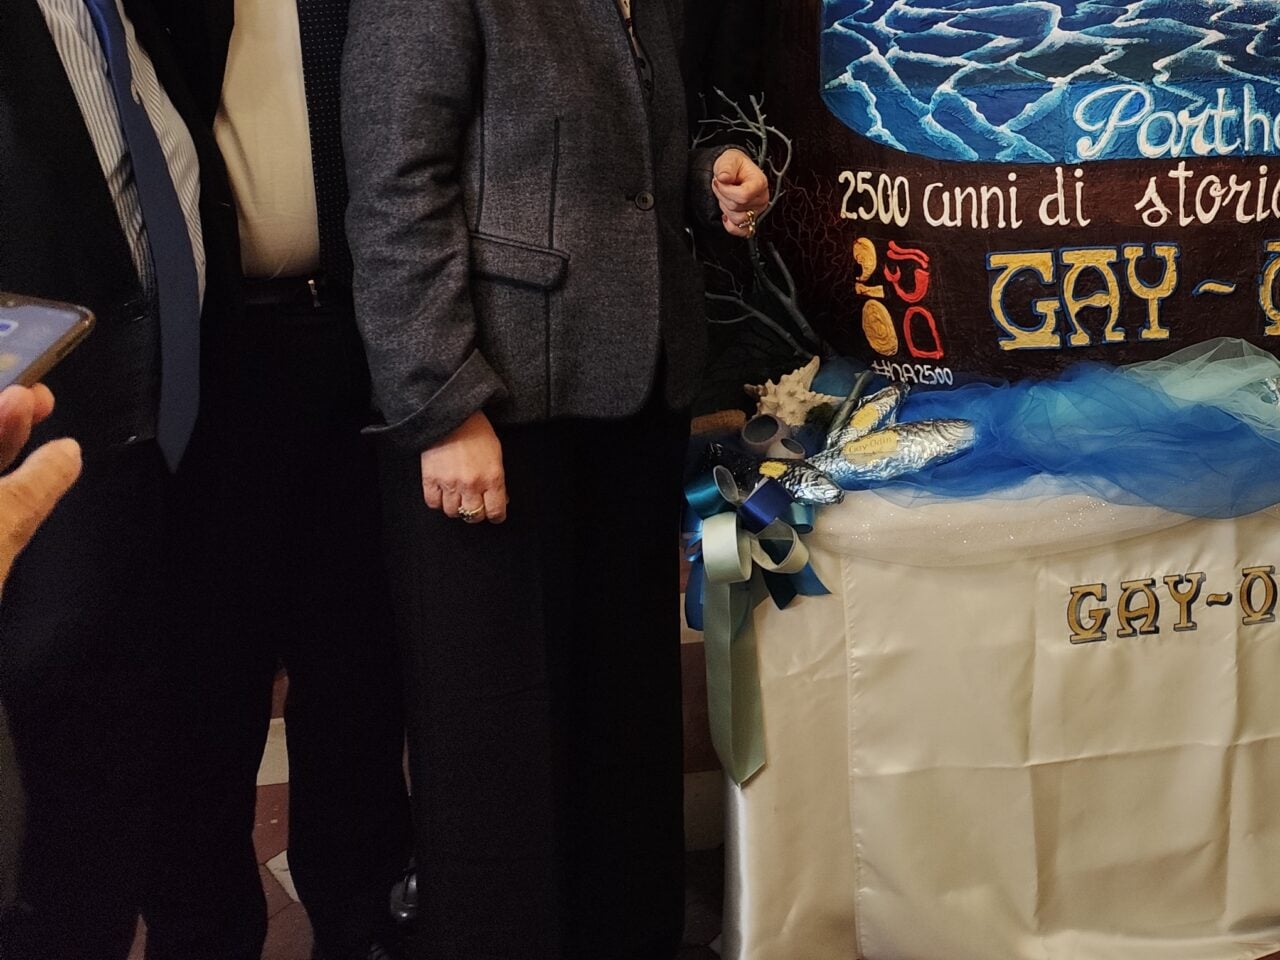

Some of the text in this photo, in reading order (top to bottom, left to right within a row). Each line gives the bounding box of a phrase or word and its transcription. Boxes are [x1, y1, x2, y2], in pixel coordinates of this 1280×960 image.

[838, 170, 910, 227] 2500
[922, 171, 1022, 229] anni
[1038, 166, 1091, 227] di
